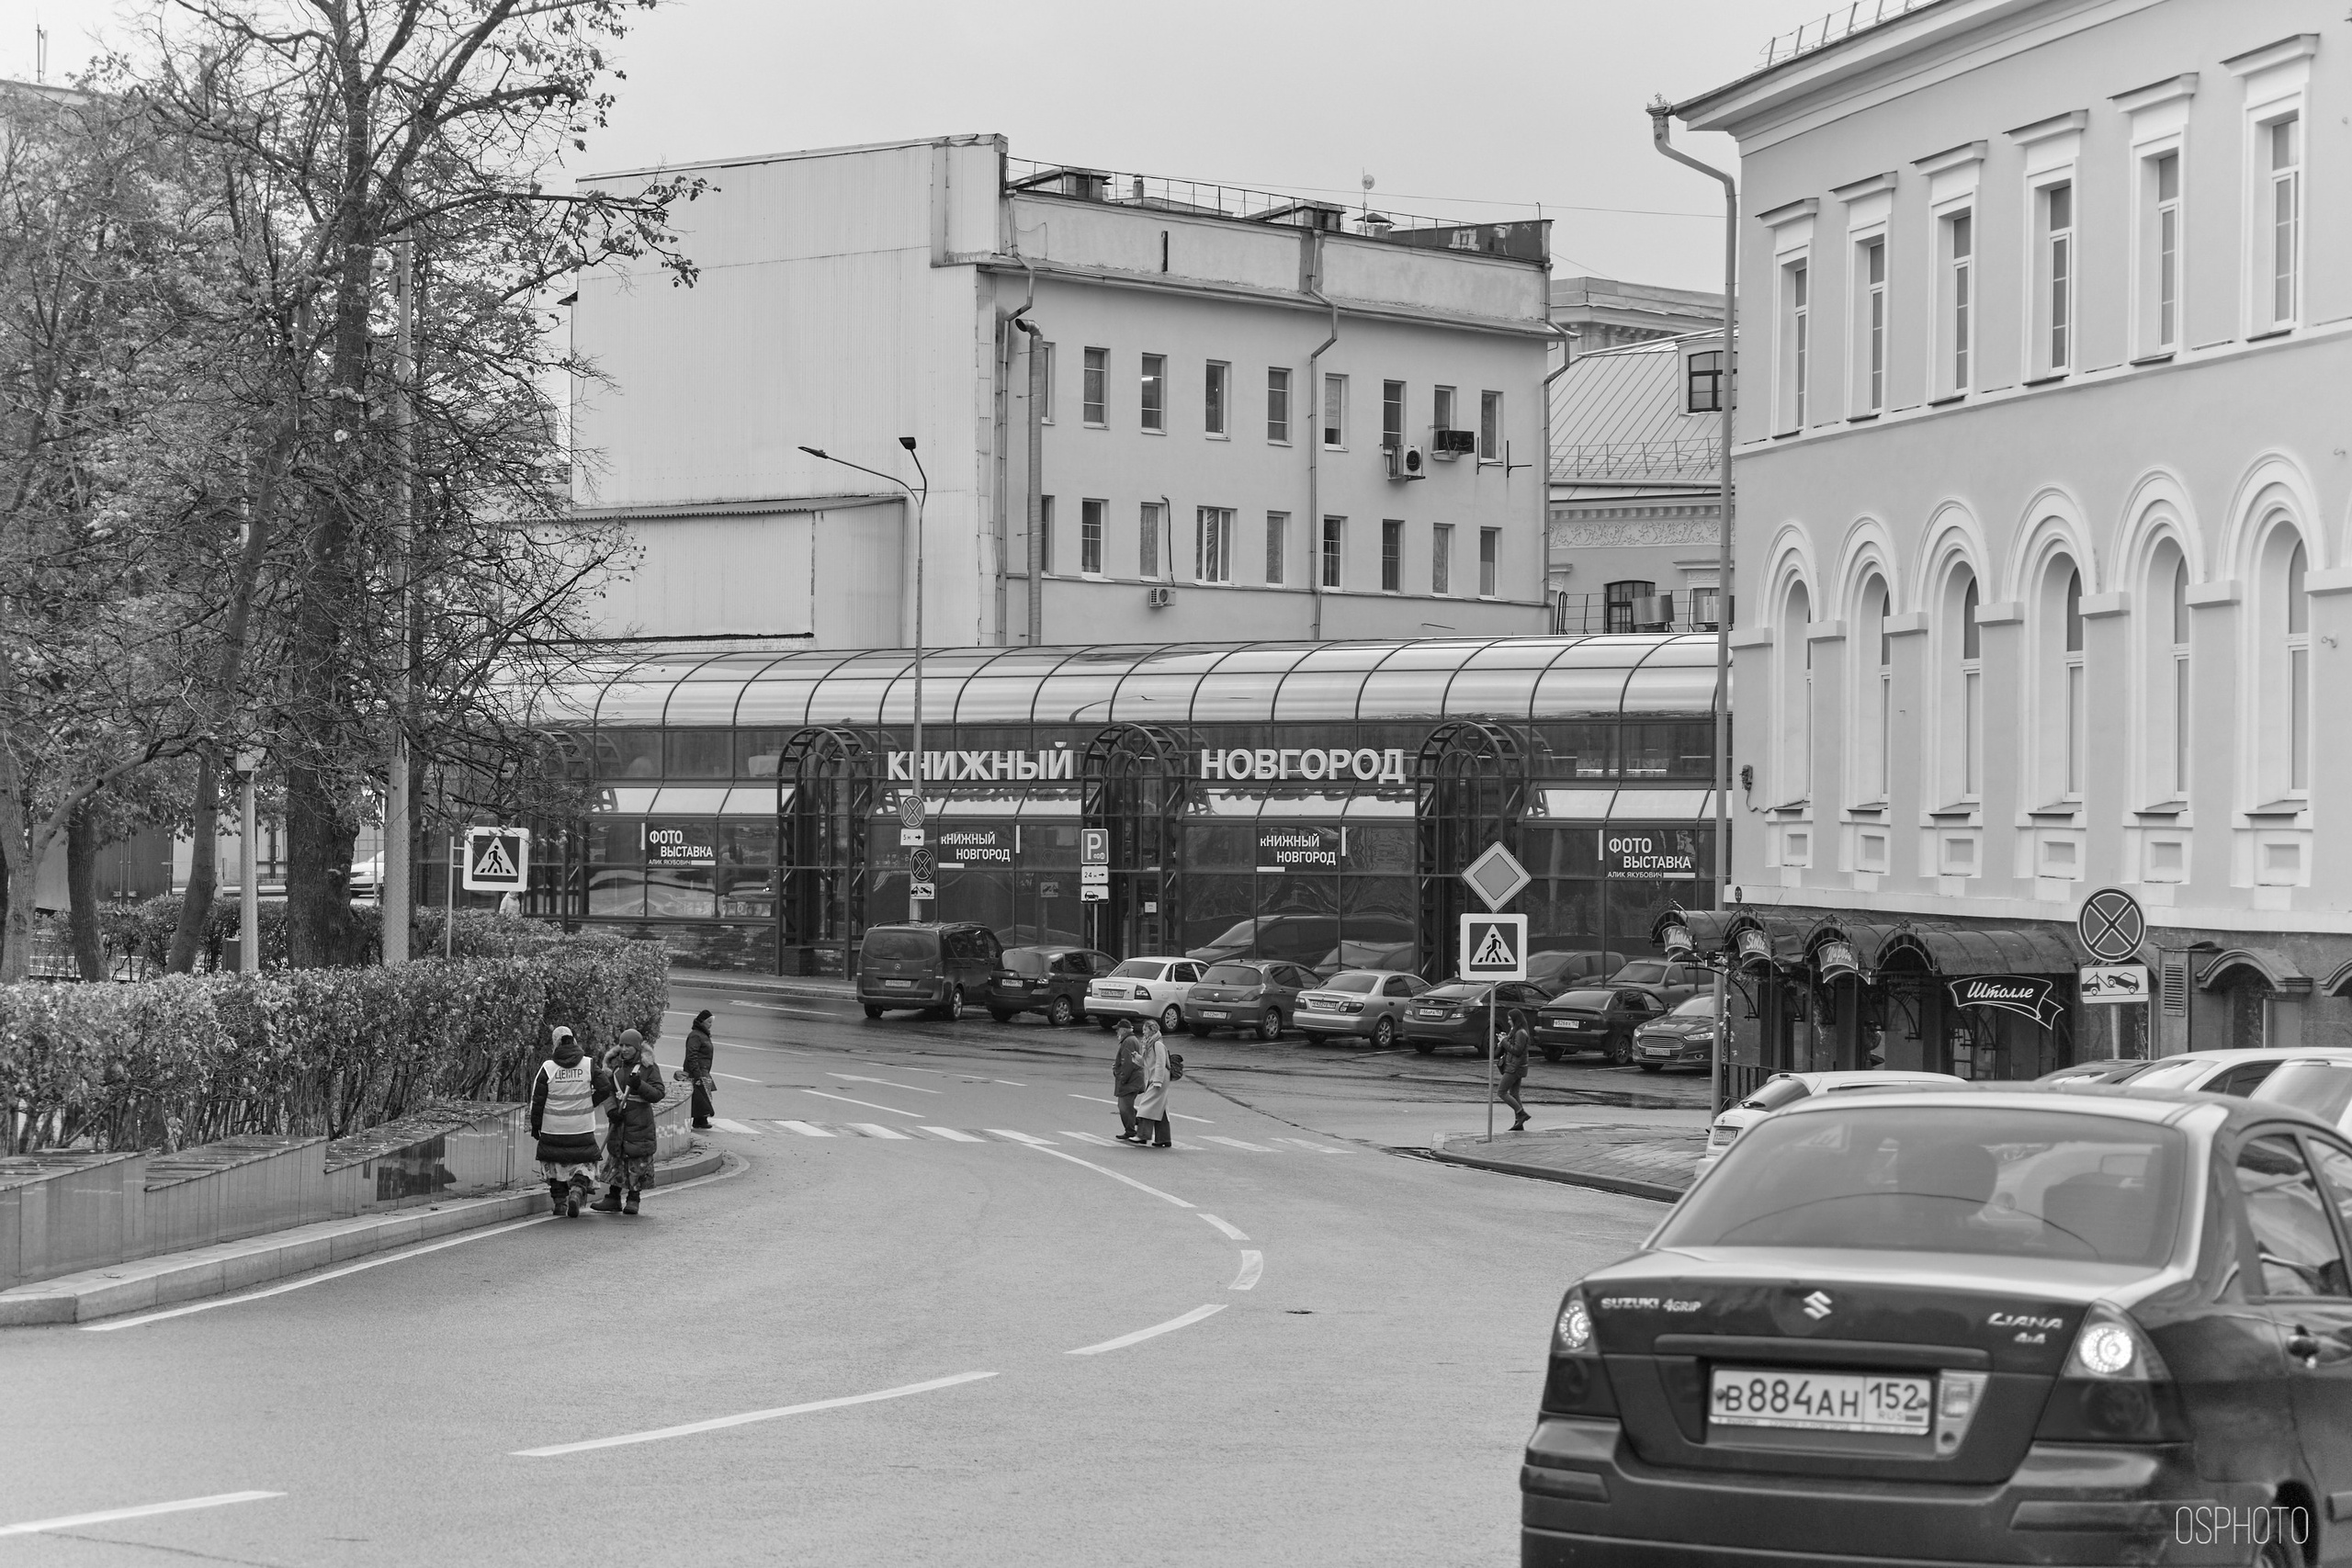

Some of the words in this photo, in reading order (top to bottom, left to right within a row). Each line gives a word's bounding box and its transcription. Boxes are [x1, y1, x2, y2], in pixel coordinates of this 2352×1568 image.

[888, 741, 1074, 781] КНИЖНЫЙ
[1200, 748, 1407, 784] НОВГОРОД
[649, 829, 684, 844] ФОТО
[660, 846, 714, 858] ВЫСТАВКА
[1087, 833, 1102, 860] P
[1608, 837, 1652, 853] ФОТО
[956, 848, 1011, 863] НОВГОРОД
[1276, 852, 1336, 865] НОВГОРОД
[1623, 855, 1692, 869] ВЫСТАВКА
[1966, 981, 2034, 998] Штолле
[555, 1068, 583, 1080] ЦЕНТР
[1600, 1297, 1660, 1310] SUZUKI
[1869, 1382, 1920, 1411] 152
[1877, 1410, 1904, 1421] RUS
